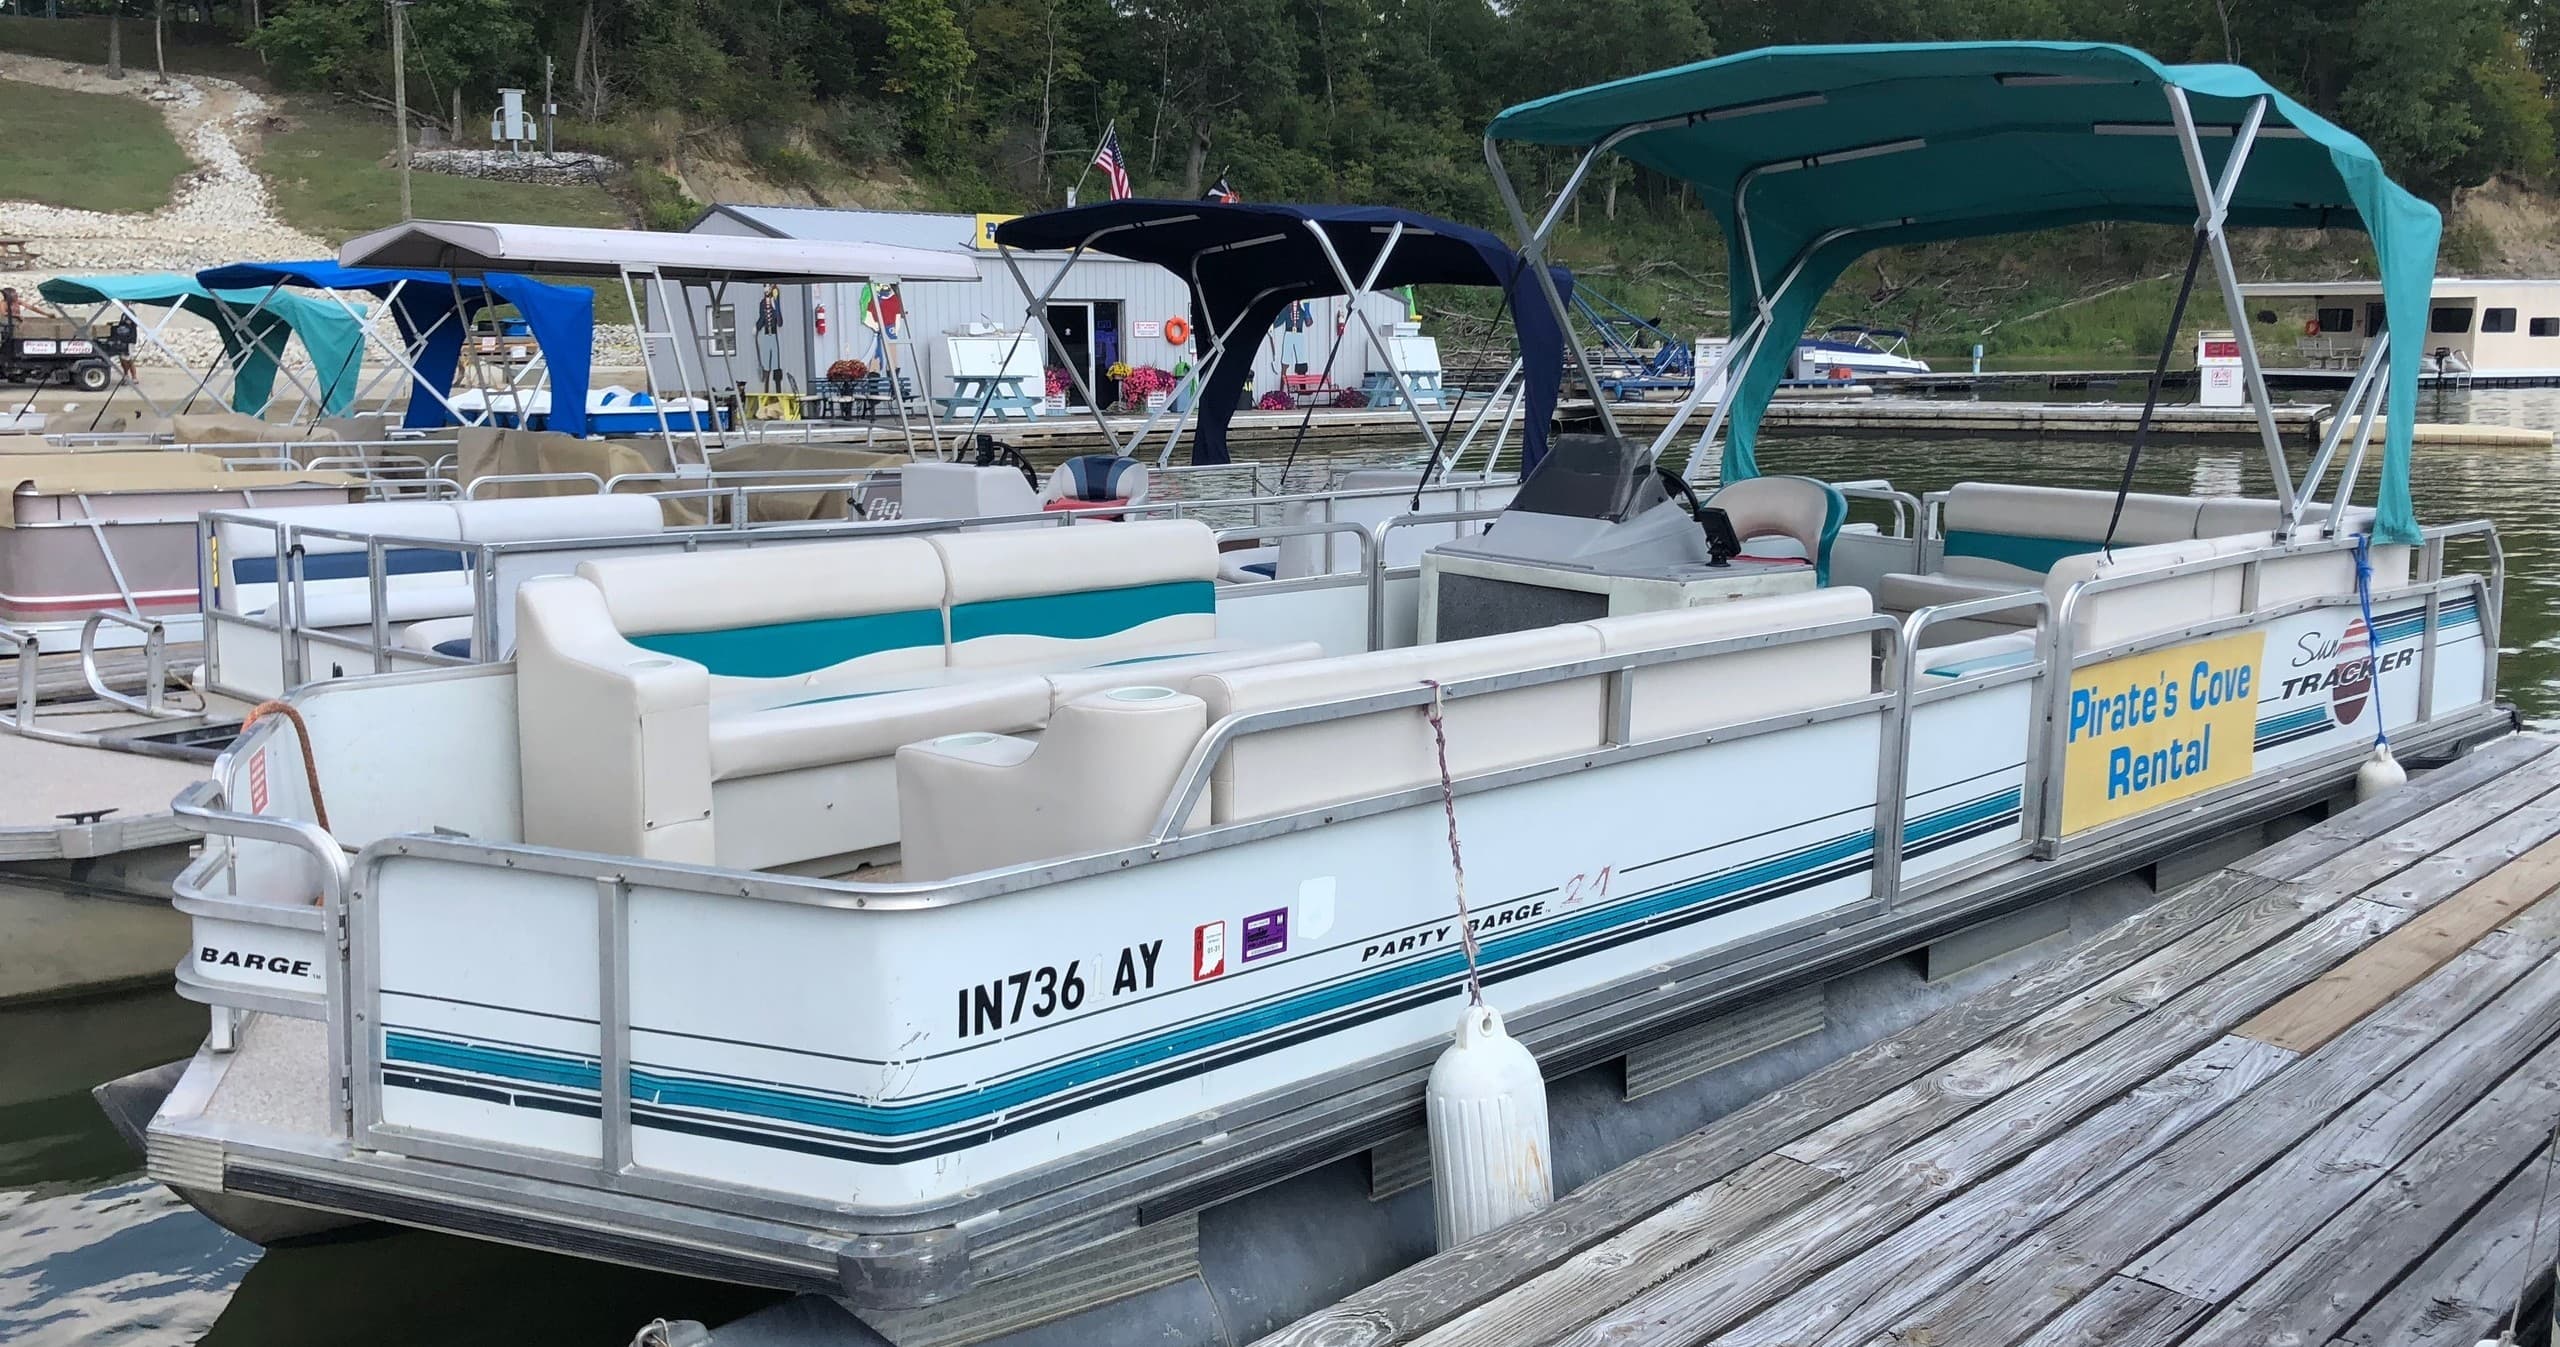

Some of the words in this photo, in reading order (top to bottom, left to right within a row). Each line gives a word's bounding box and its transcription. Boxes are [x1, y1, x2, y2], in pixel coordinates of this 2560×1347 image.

[2282, 648, 2414, 700] TRACKER
[2292, 631, 2342, 667] Sun
[2069, 670, 2178, 743] Pirate's
[2190, 661, 2250, 710] Cove
[2109, 723, 2210, 800] Rental
[1361, 926, 1451, 962] PARTY
[1467, 901, 1545, 931] BARGE
[200, 947, 312, 977] BARGE
[1112, 939, 1163, 996] AY
